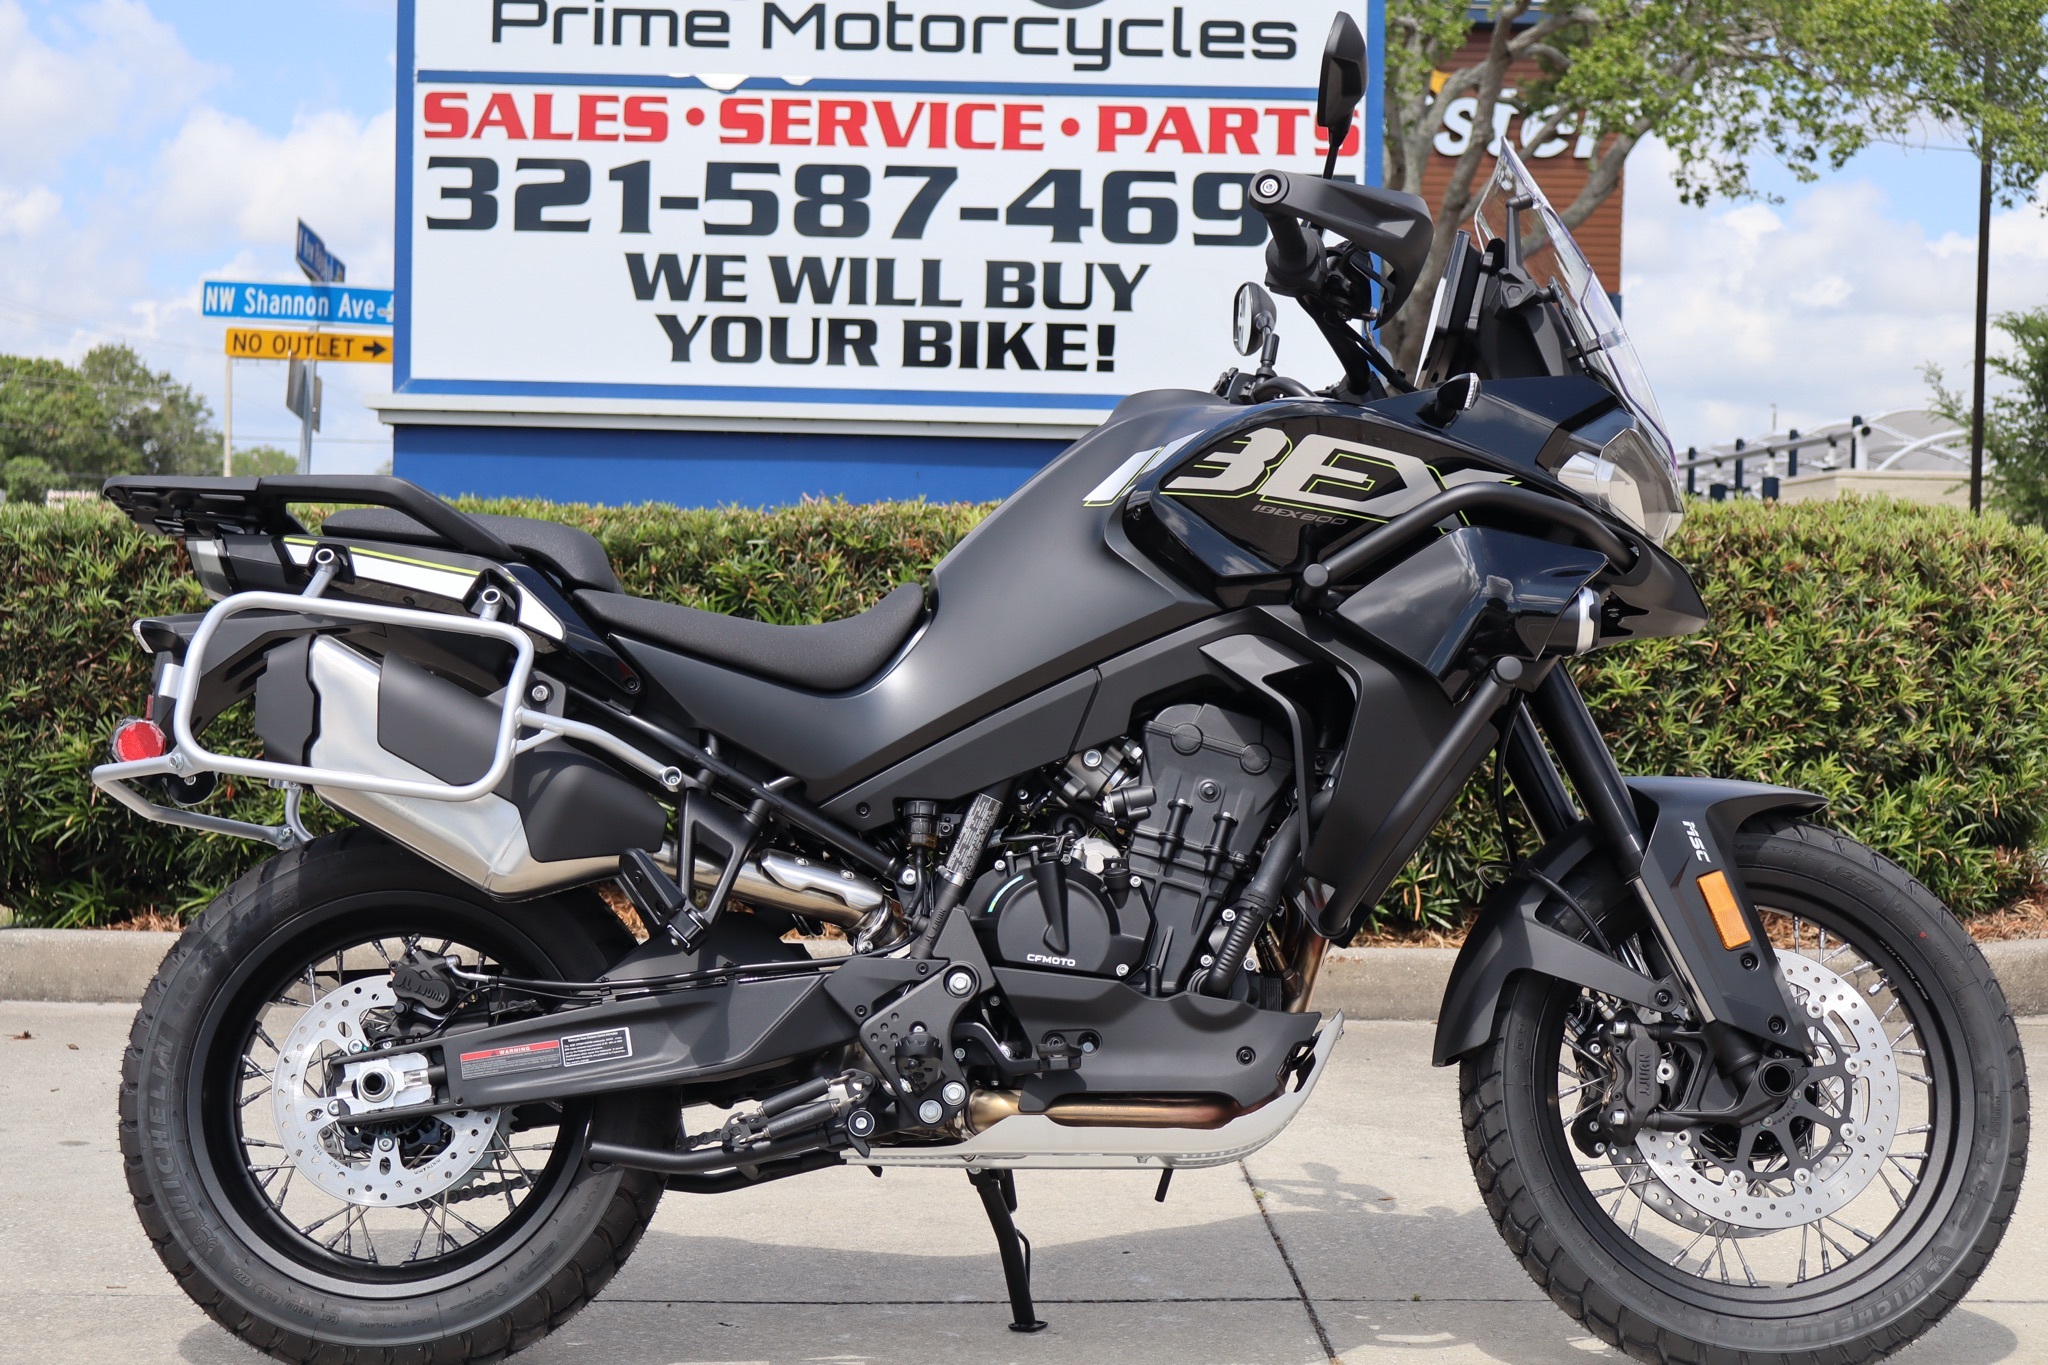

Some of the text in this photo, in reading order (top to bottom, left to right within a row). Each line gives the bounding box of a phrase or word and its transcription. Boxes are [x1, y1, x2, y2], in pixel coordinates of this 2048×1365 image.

[492, 0, 1297, 71] Prime Motorcycles
[423, 92, 669, 142] SALES
[719, 98, 1044, 151] SERVICE
[426, 156, 1356, 247] 321-587-469
[205, 285, 236, 313] NW
[243, 286, 330, 317] Shannon
[337, 292, 376, 320] Ave
[624, 252, 1151, 312] WE WILL BUY
[232, 333, 355, 358] NO OUTLET
[655, 314, 1116, 373] YOUR BIKE!
[1252, 504, 1349, 525] IBEX 800
[1682, 820, 1712, 863] MSC
[1027, 953, 1076, 967] CFMOTO
[499, 1046, 531, 1055] WARNING
[149, 1034, 197, 1226] MICHELIN
[1784, 1274, 1928, 1344] MICHELIN
